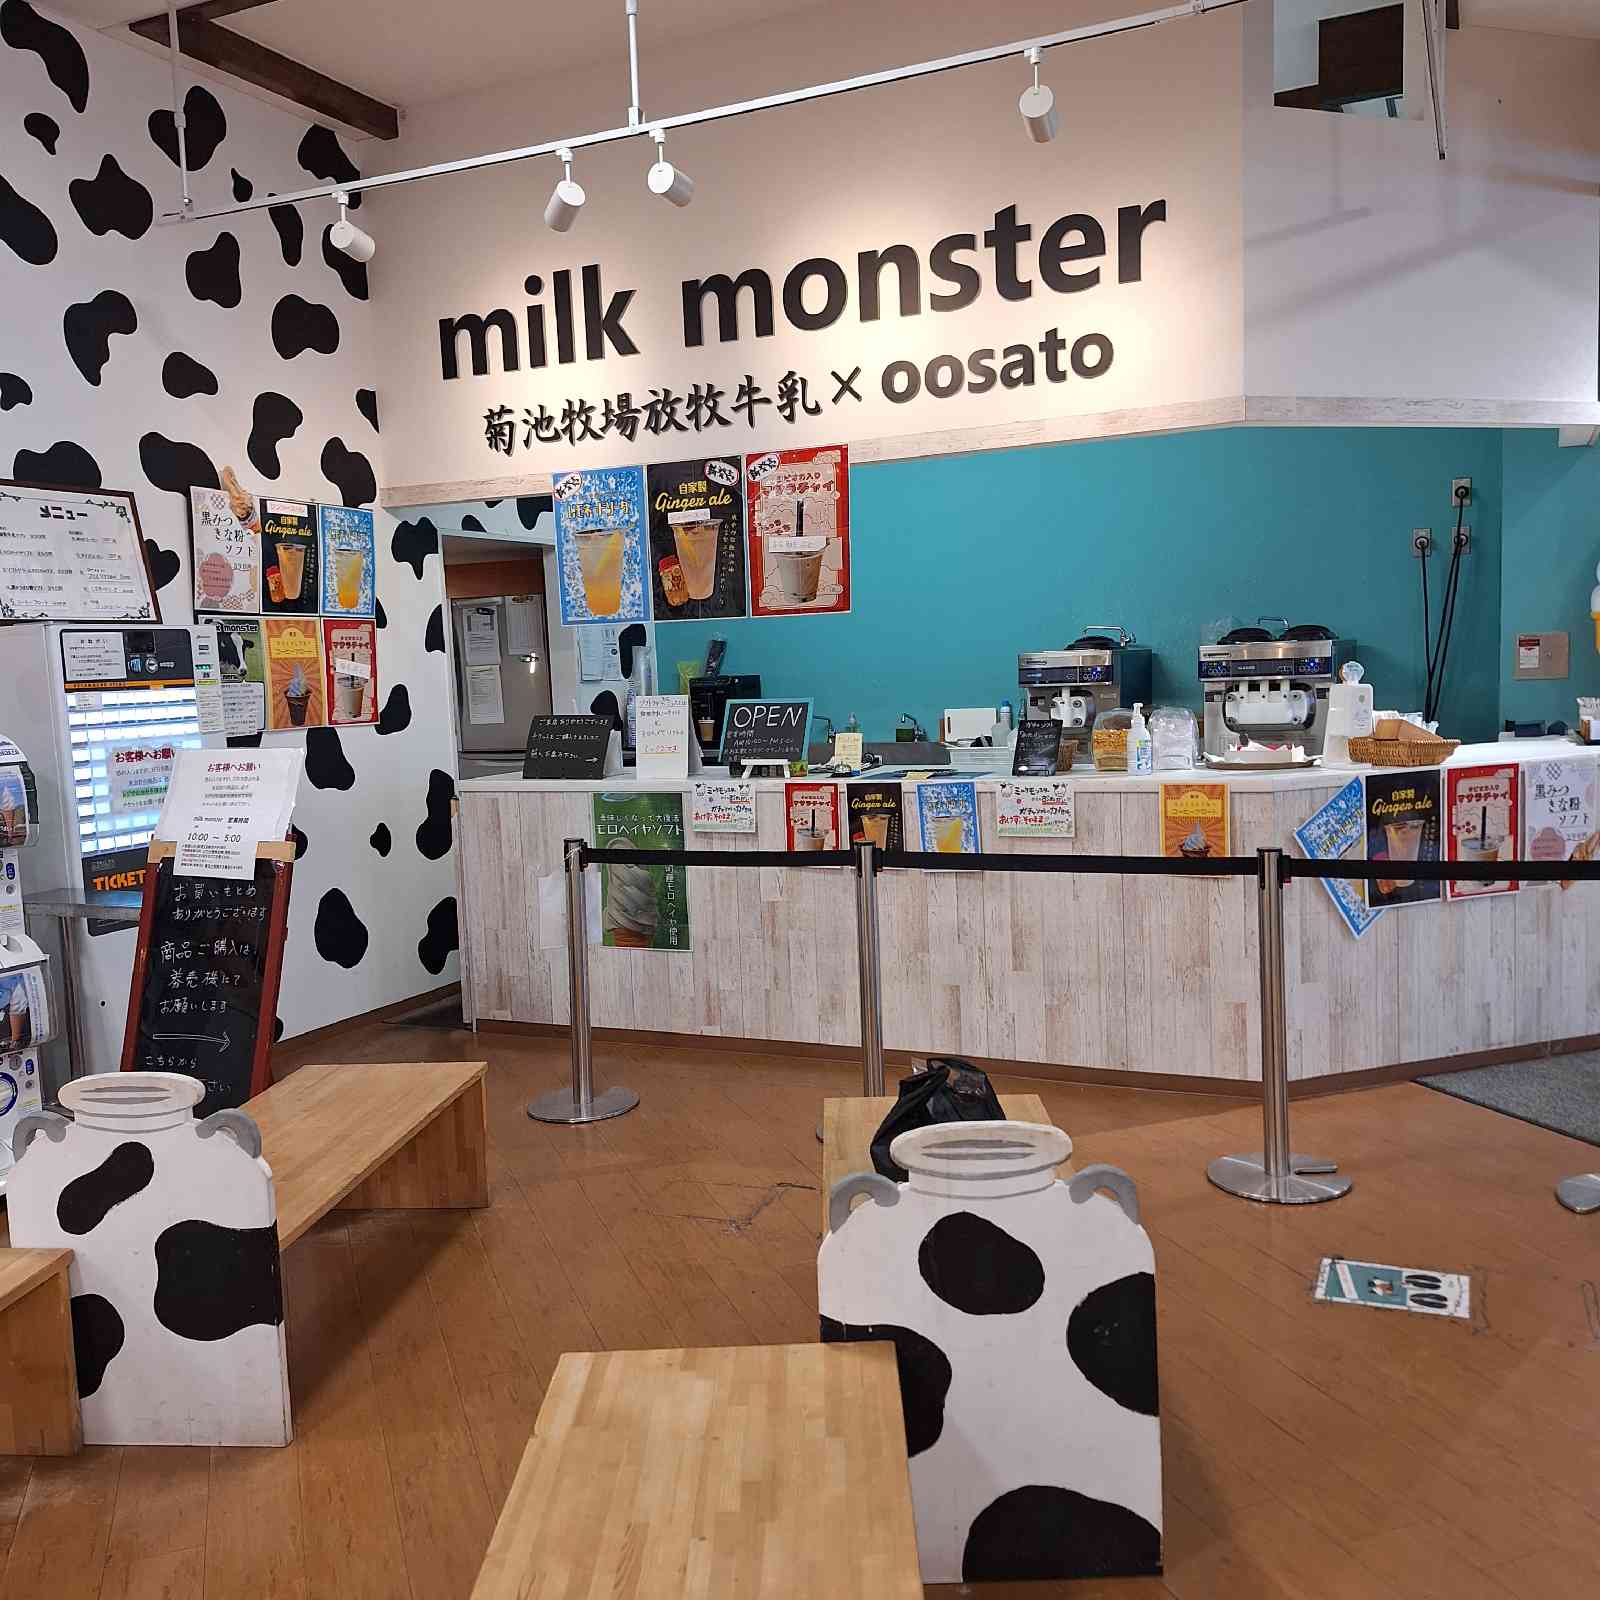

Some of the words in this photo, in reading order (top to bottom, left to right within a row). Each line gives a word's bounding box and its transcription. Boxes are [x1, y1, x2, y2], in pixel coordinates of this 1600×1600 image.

[438, 263, 641, 381] milk
[681, 198, 1167, 348] monster
[483, 370, 821, 456] 菊池牧場放牧牛乳
[881, 327, 1114, 404] oosato
[680, 480, 707, 494] 自家製
[655, 492, 707, 513] Ginger
[708, 487, 733, 506] ale
[39, 504, 88, 521] メニュー
[201, 511, 233, 527] 黒みつ
[214, 527, 244, 543] きな粉
[264, 519, 298, 539] Ginger
[298, 523, 313, 536] ale
[225, 544, 255, 557] ソフト
[733, 705, 803, 728] OPEN
[1534, 783, 1570, 800] 黒みつ
[851, 798, 882, 811] Ginger
[881, 797, 897, 808] ale
[1371, 798, 1413, 817] Ginger
[1414, 793, 1433, 810] ale
[1548, 796, 1581, 813] きな粉
[1558, 813, 1590, 826] ソフト
[187, 832, 209, 841] 10:00
[224, 833, 241, 843] 5:00
[595, 824, 685, 836] モロヘイヤソフト
[93, 869, 146, 890] TICKET
[159, 996, 228, 1014] お願いします
[145, 1055, 199, 1070] こちらから
